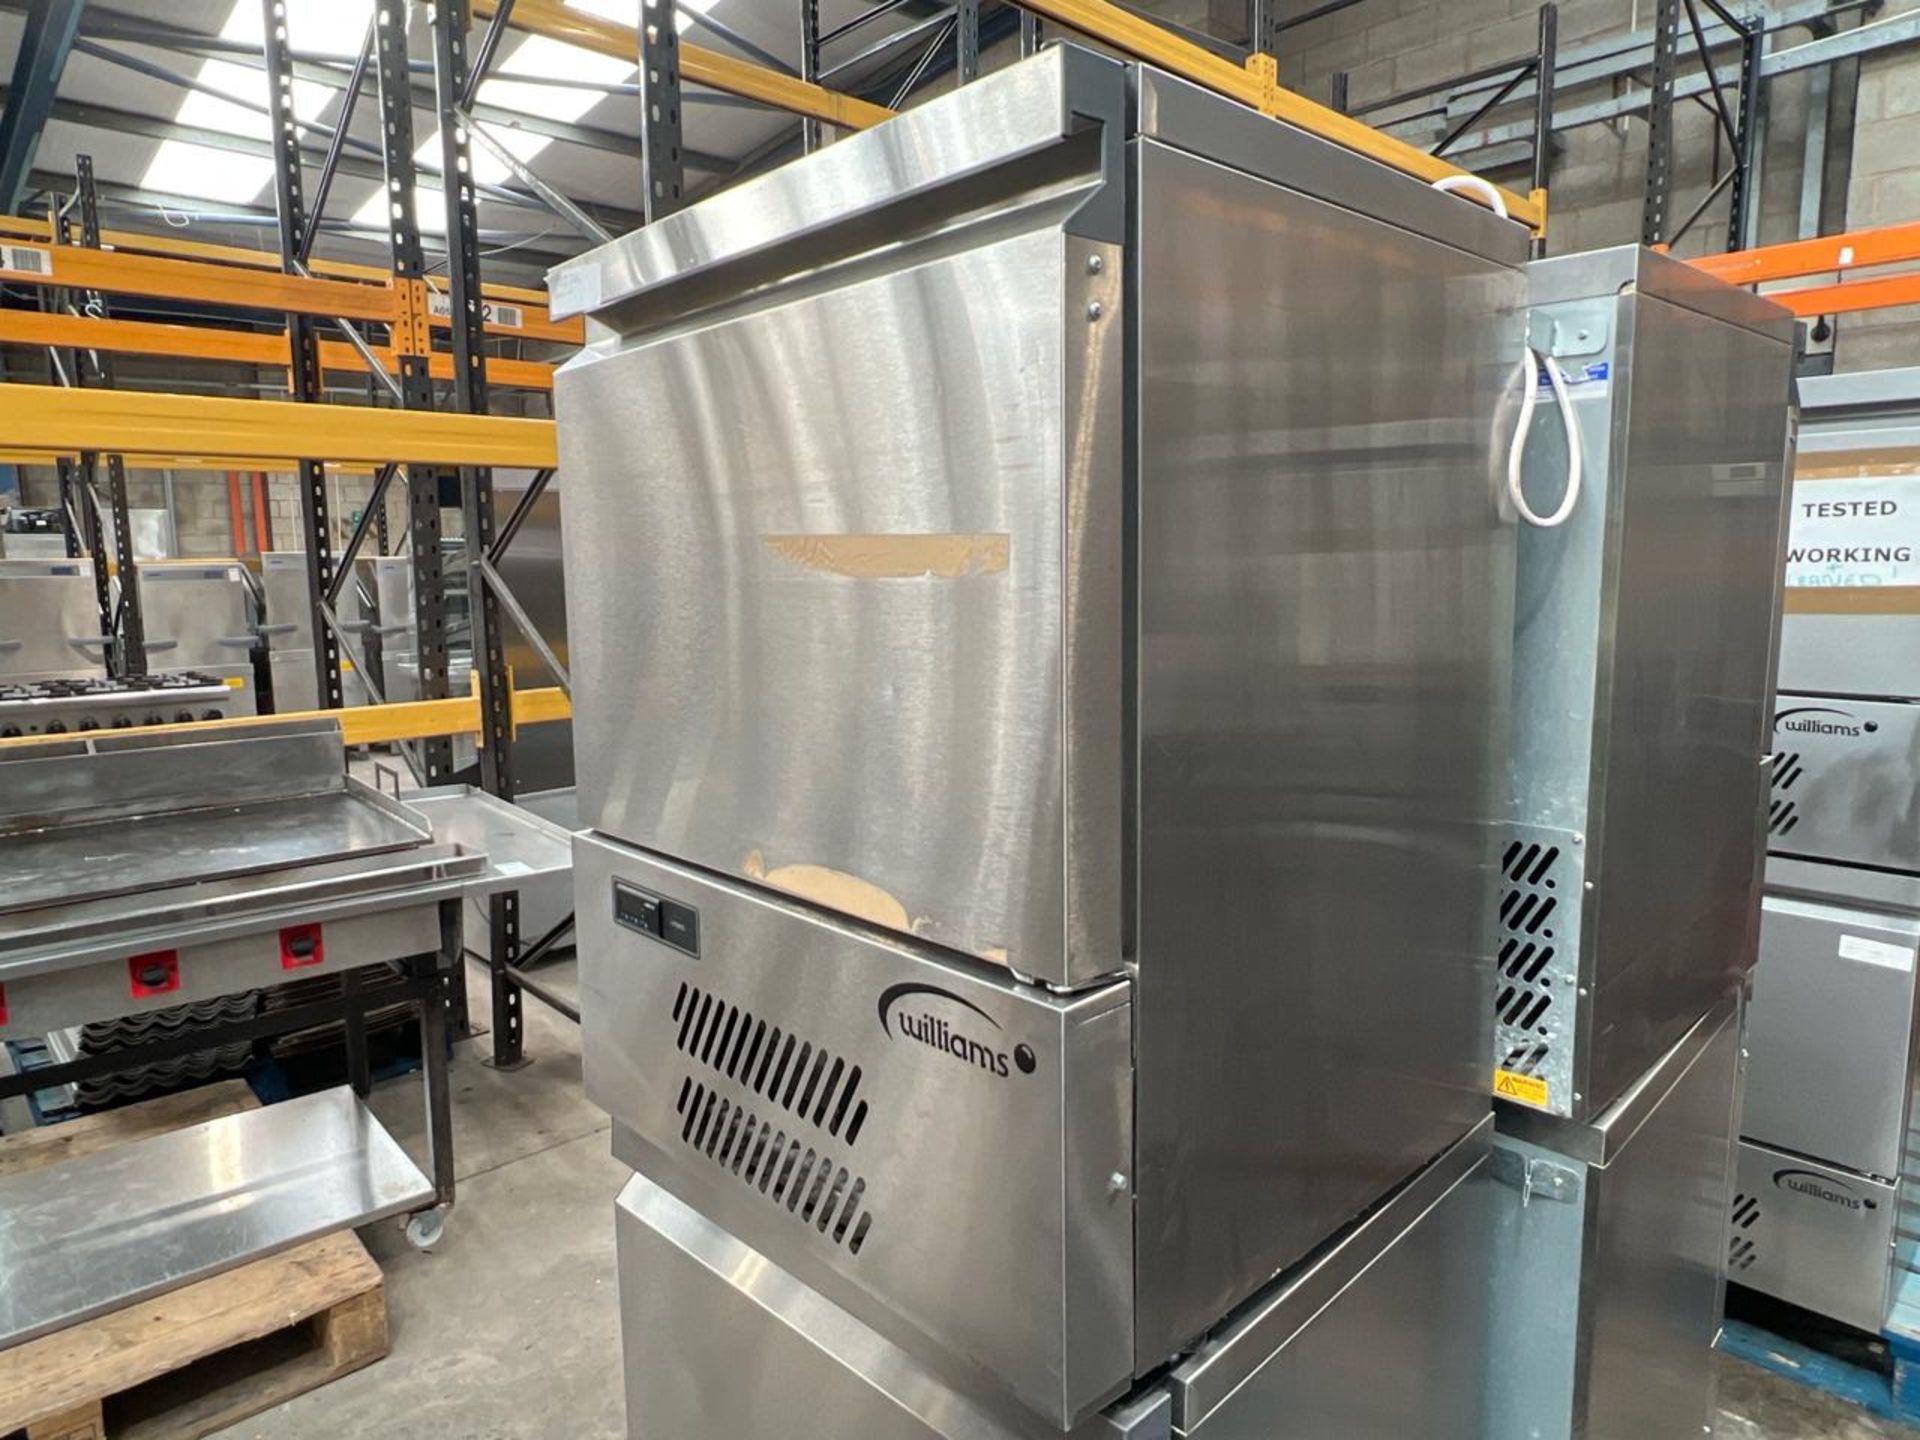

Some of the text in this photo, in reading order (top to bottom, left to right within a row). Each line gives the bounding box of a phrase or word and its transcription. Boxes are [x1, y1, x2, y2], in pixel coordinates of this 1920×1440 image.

[1802, 500, 1897, 518] TESTED
[1786, 547, 1911, 563] WORKING
[1785, 719, 1860, 737] williams
[899, 1011, 1009, 1078] williams
[1787, 1177, 1860, 1210] williams
